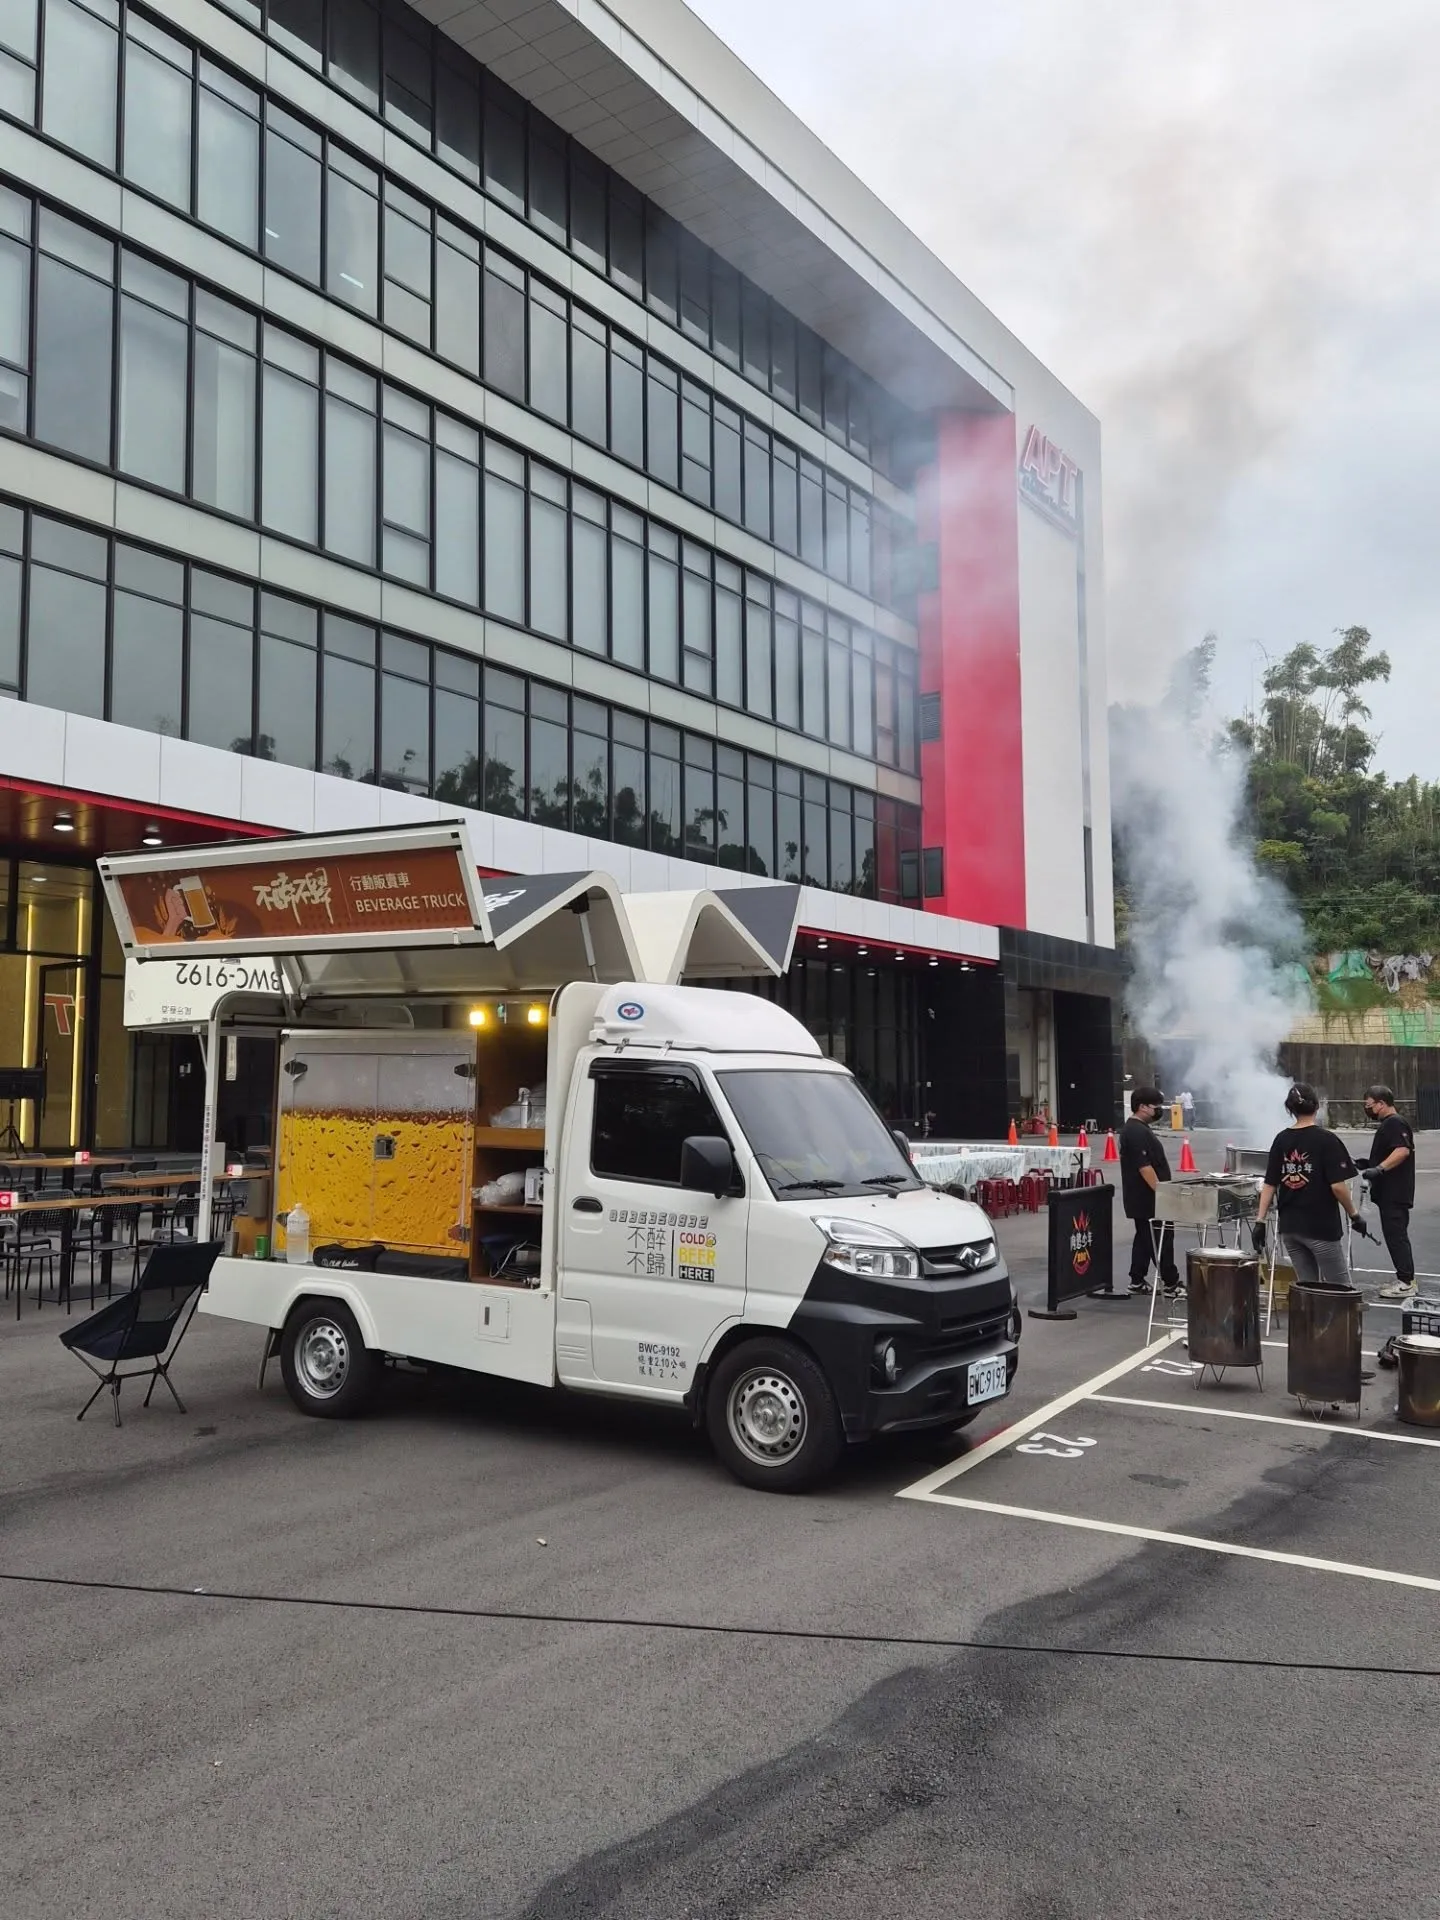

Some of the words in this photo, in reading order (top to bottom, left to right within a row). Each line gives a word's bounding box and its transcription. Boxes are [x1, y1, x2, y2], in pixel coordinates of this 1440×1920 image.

[349, 872, 412, 892] 行動販賣車
[355, 896, 421, 913] BEVERAGE
[421, 893, 466, 909] TRUCK
[626, 1226, 667, 1251] 不醉
[679, 1232, 706, 1245] COLD
[626, 1250, 666, 1276] 不歸
[678, 1247, 716, 1266] BEER
[679, 1266, 715, 1282] HERE!
[638, 1342, 681, 1357] BWC-9192
[1140, 1359, 1205, 1376] 22
[1016, 1432, 1098, 1458] 23
